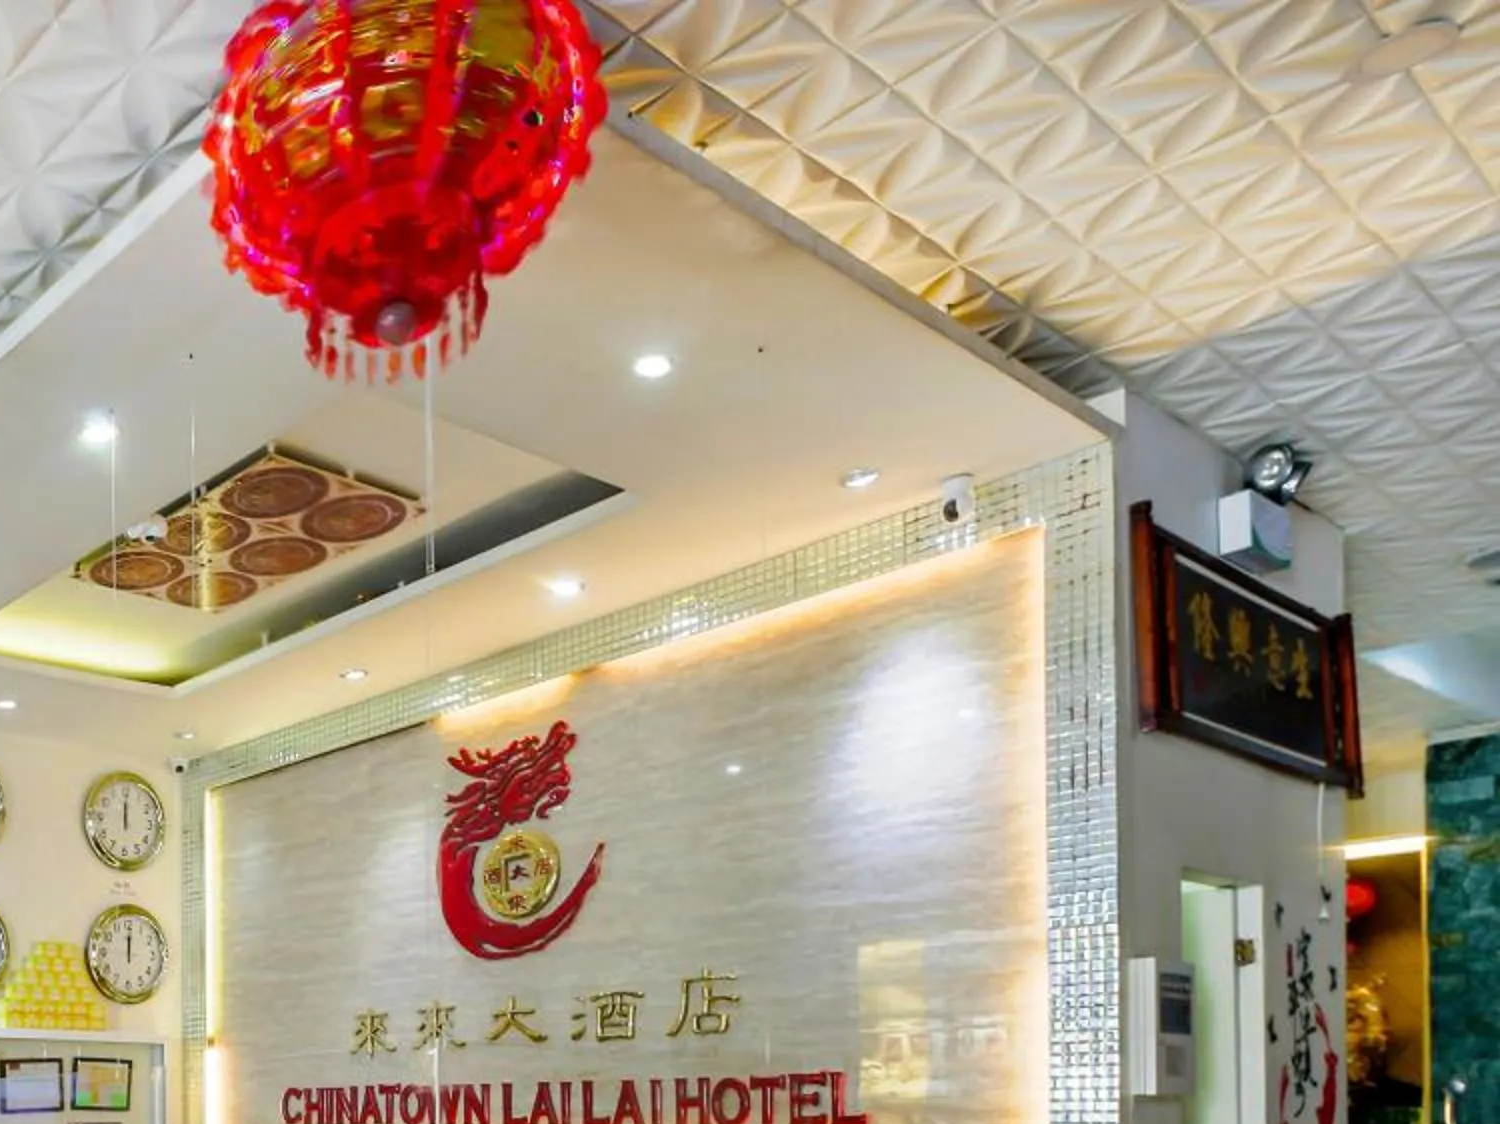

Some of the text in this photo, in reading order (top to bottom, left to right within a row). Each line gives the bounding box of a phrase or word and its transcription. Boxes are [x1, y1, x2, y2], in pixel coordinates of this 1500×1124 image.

[350, 967, 742, 1057] 來來大酒店
